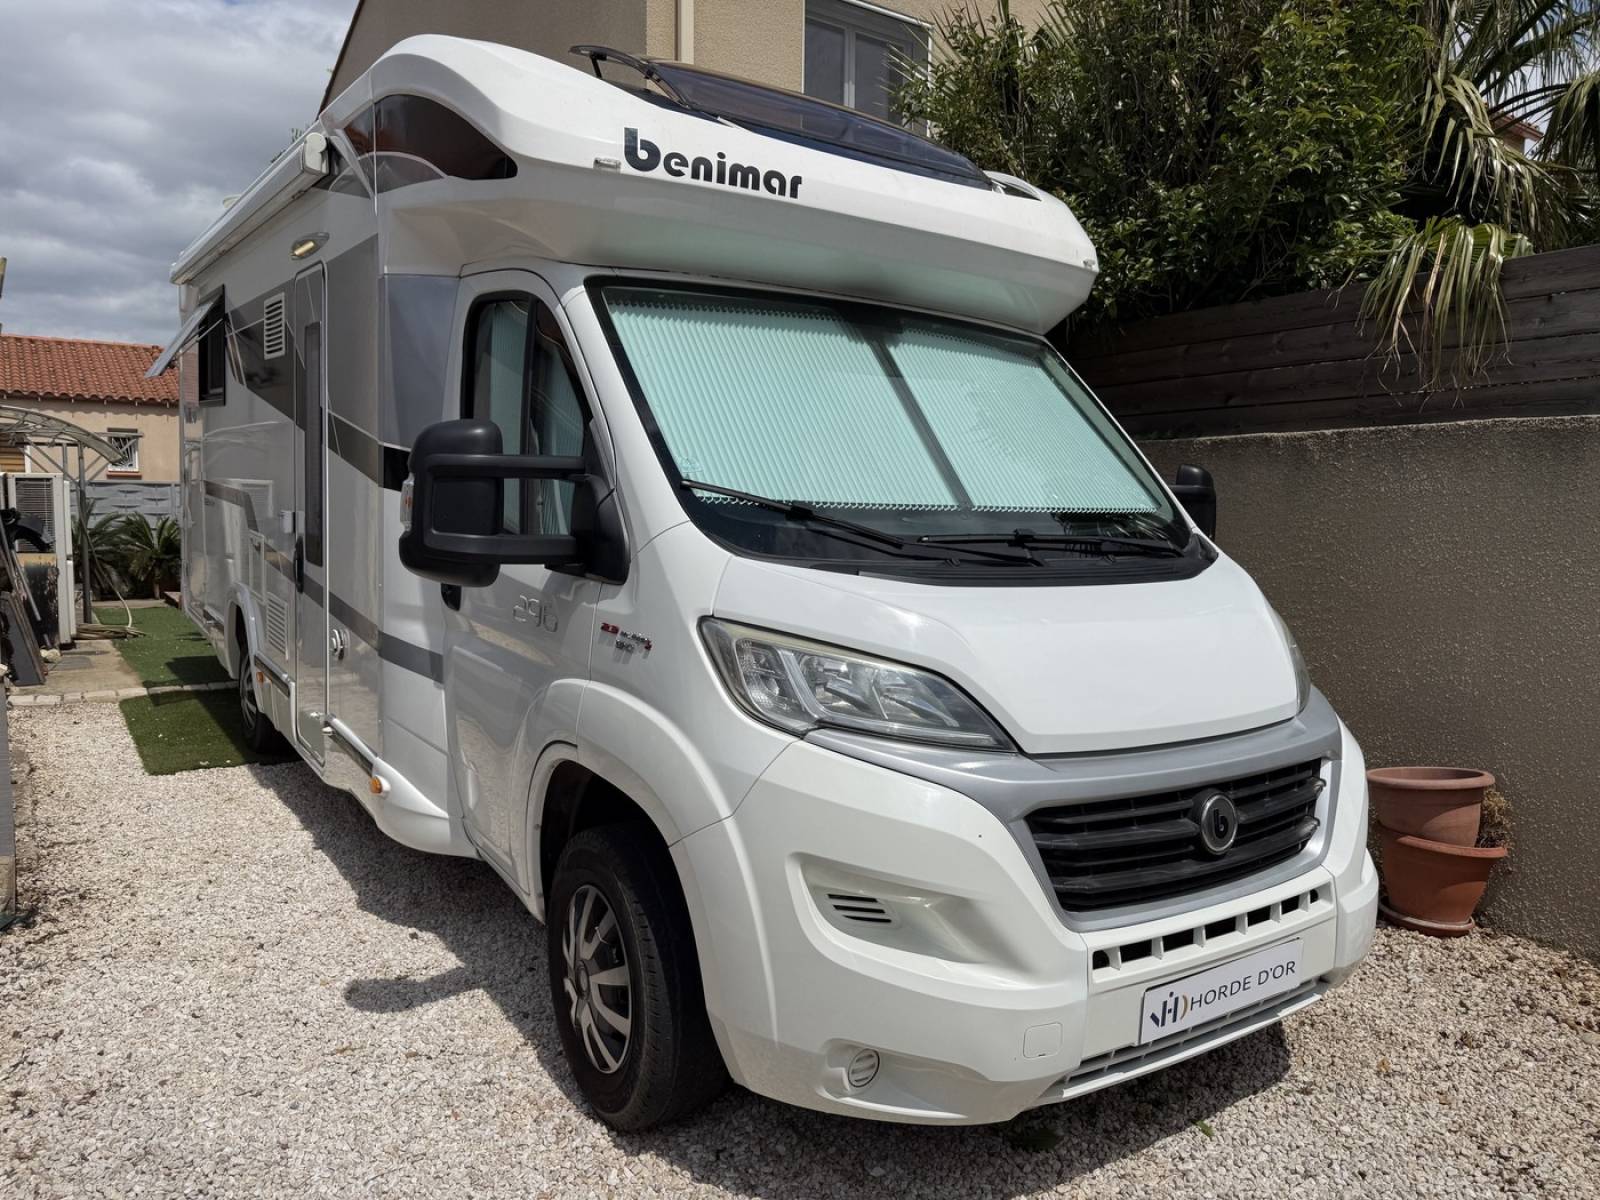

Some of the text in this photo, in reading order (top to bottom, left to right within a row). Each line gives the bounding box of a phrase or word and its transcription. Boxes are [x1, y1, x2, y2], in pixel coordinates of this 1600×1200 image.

[624, 127, 802, 199] benimar
[1190, 975, 1252, 1011] HORDE
[1257, 960, 1296, 986] D'OR
